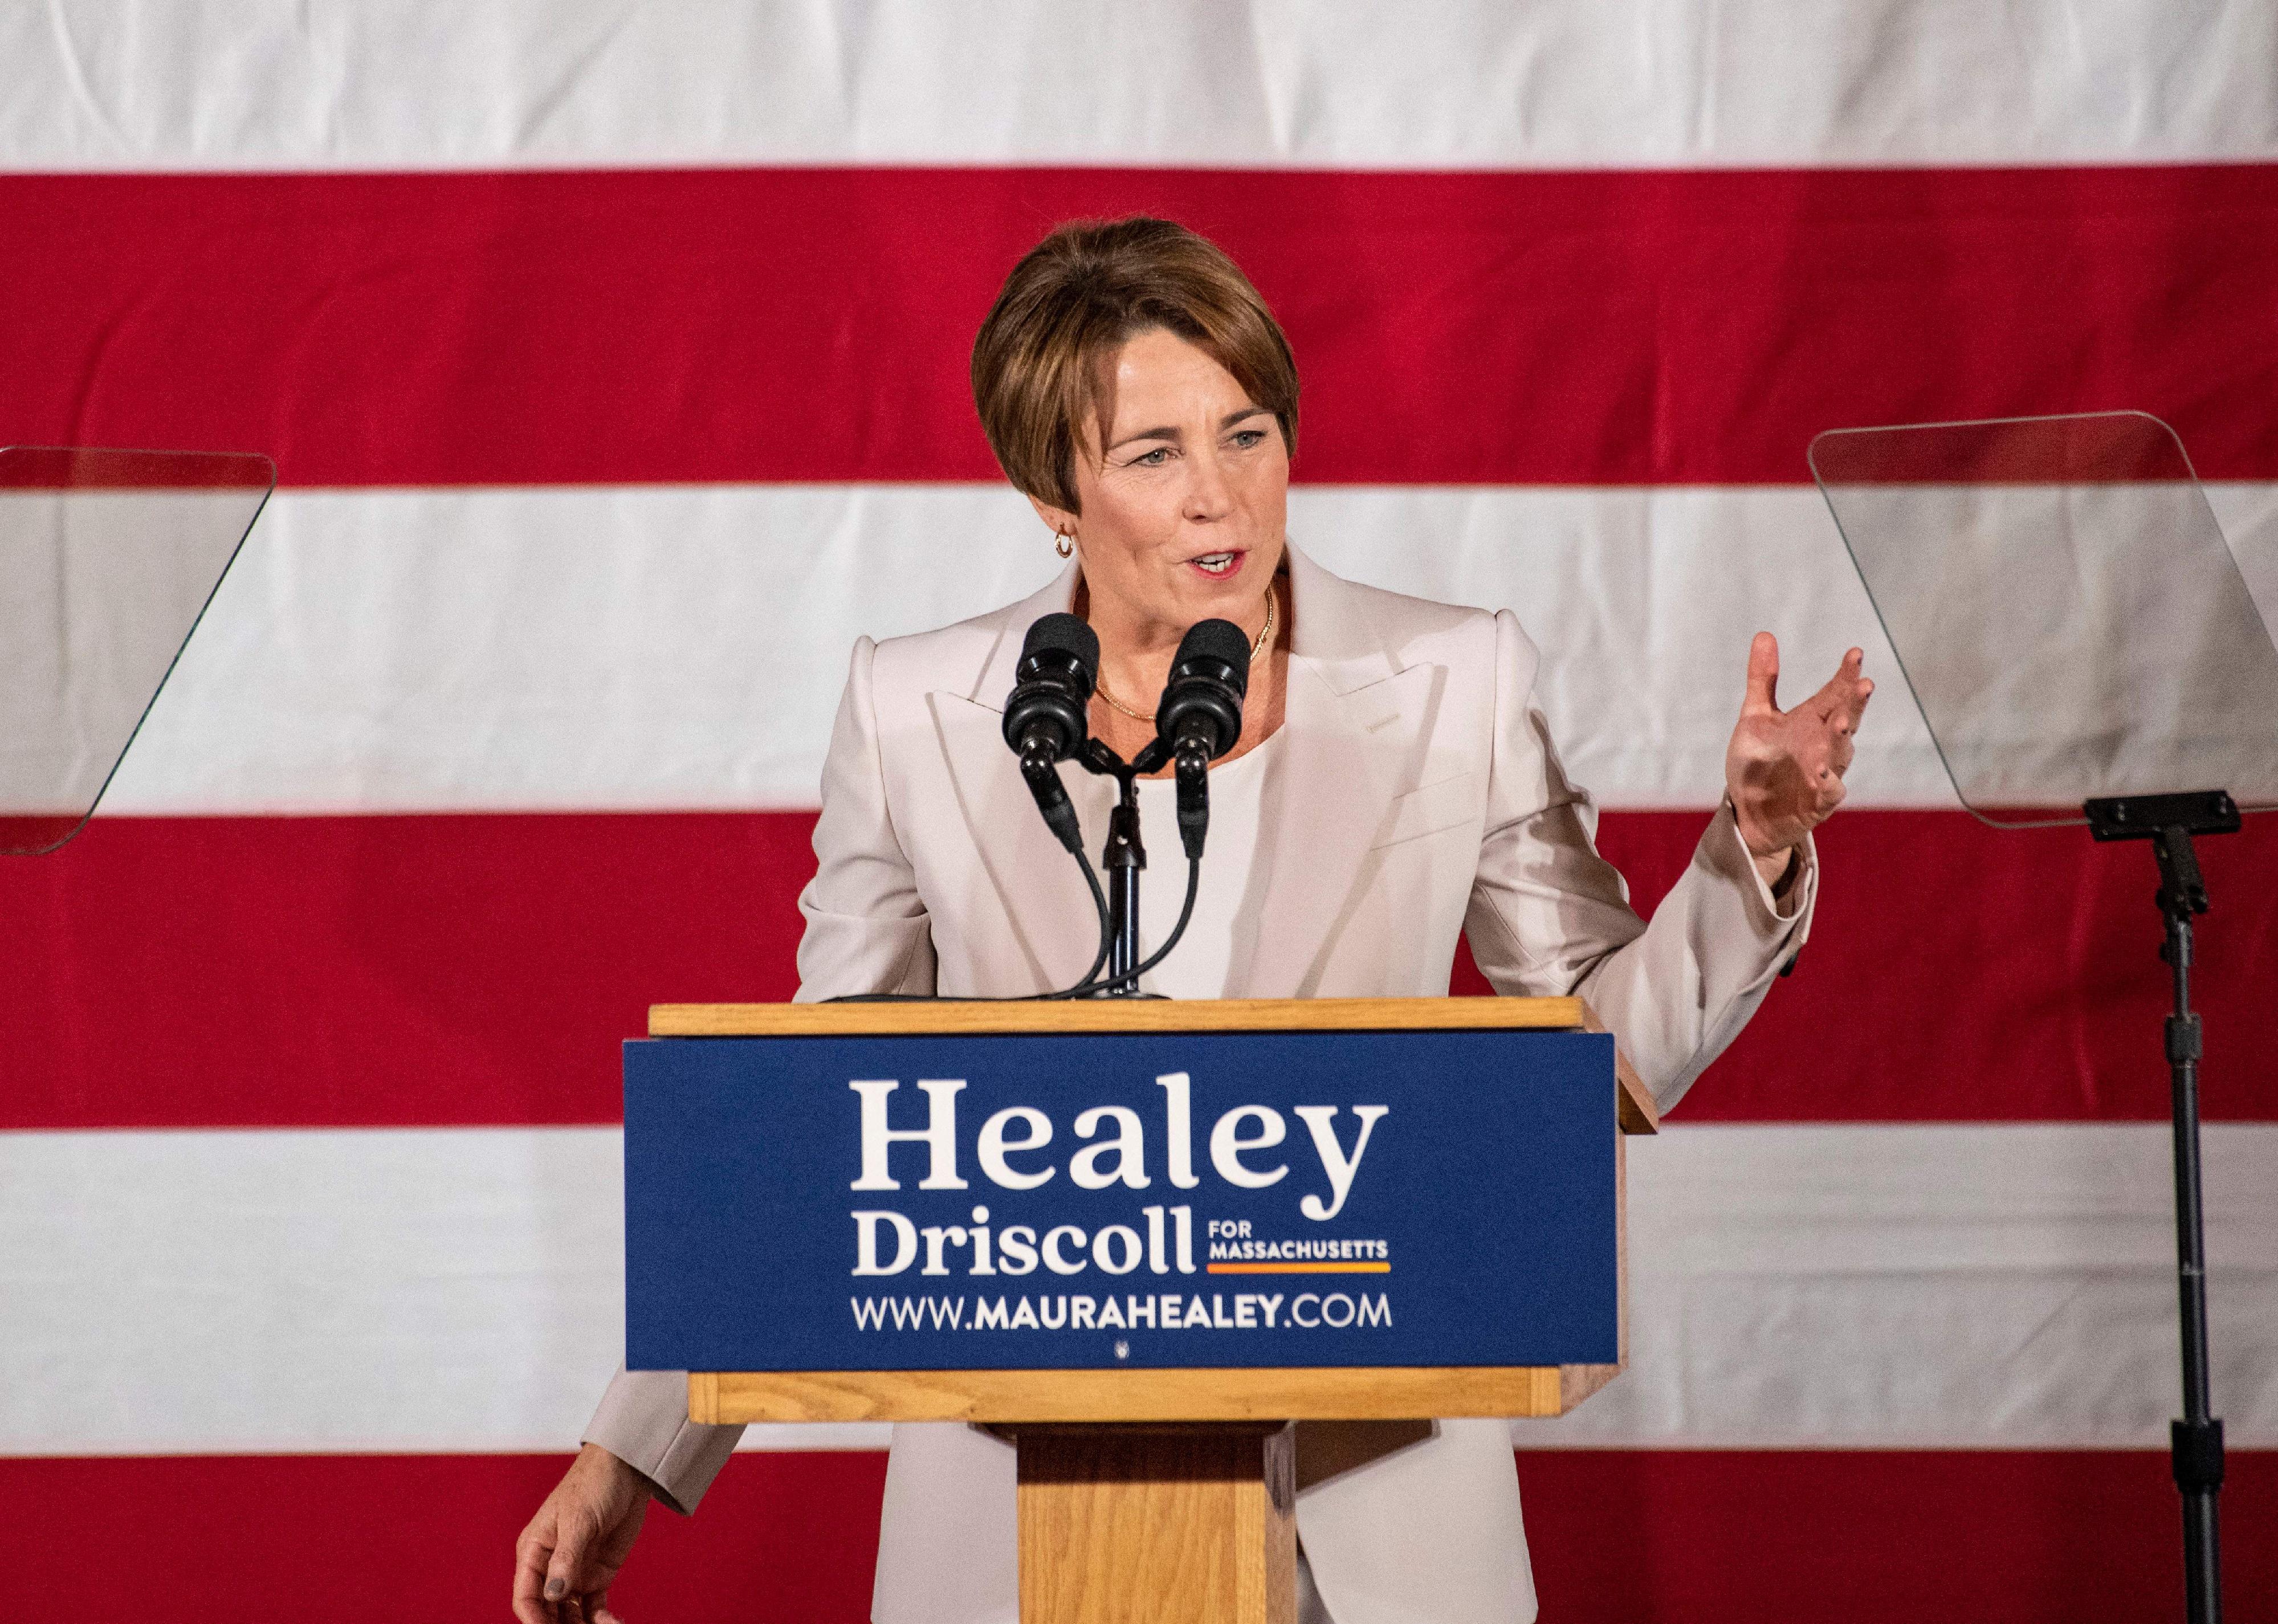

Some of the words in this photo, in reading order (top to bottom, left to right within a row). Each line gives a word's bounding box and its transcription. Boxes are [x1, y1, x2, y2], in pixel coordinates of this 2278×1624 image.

[848, 1071, 1389, 1221] Healey
[850, 1205, 1197, 1276] Driscoll
[1208, 1220, 1252, 1239] FOR
[1209, 1239, 1389, 1260] MASSACHUSETTS
[850, 1292, 1393, 1332] WWW.MAURAHEALEY.COM
